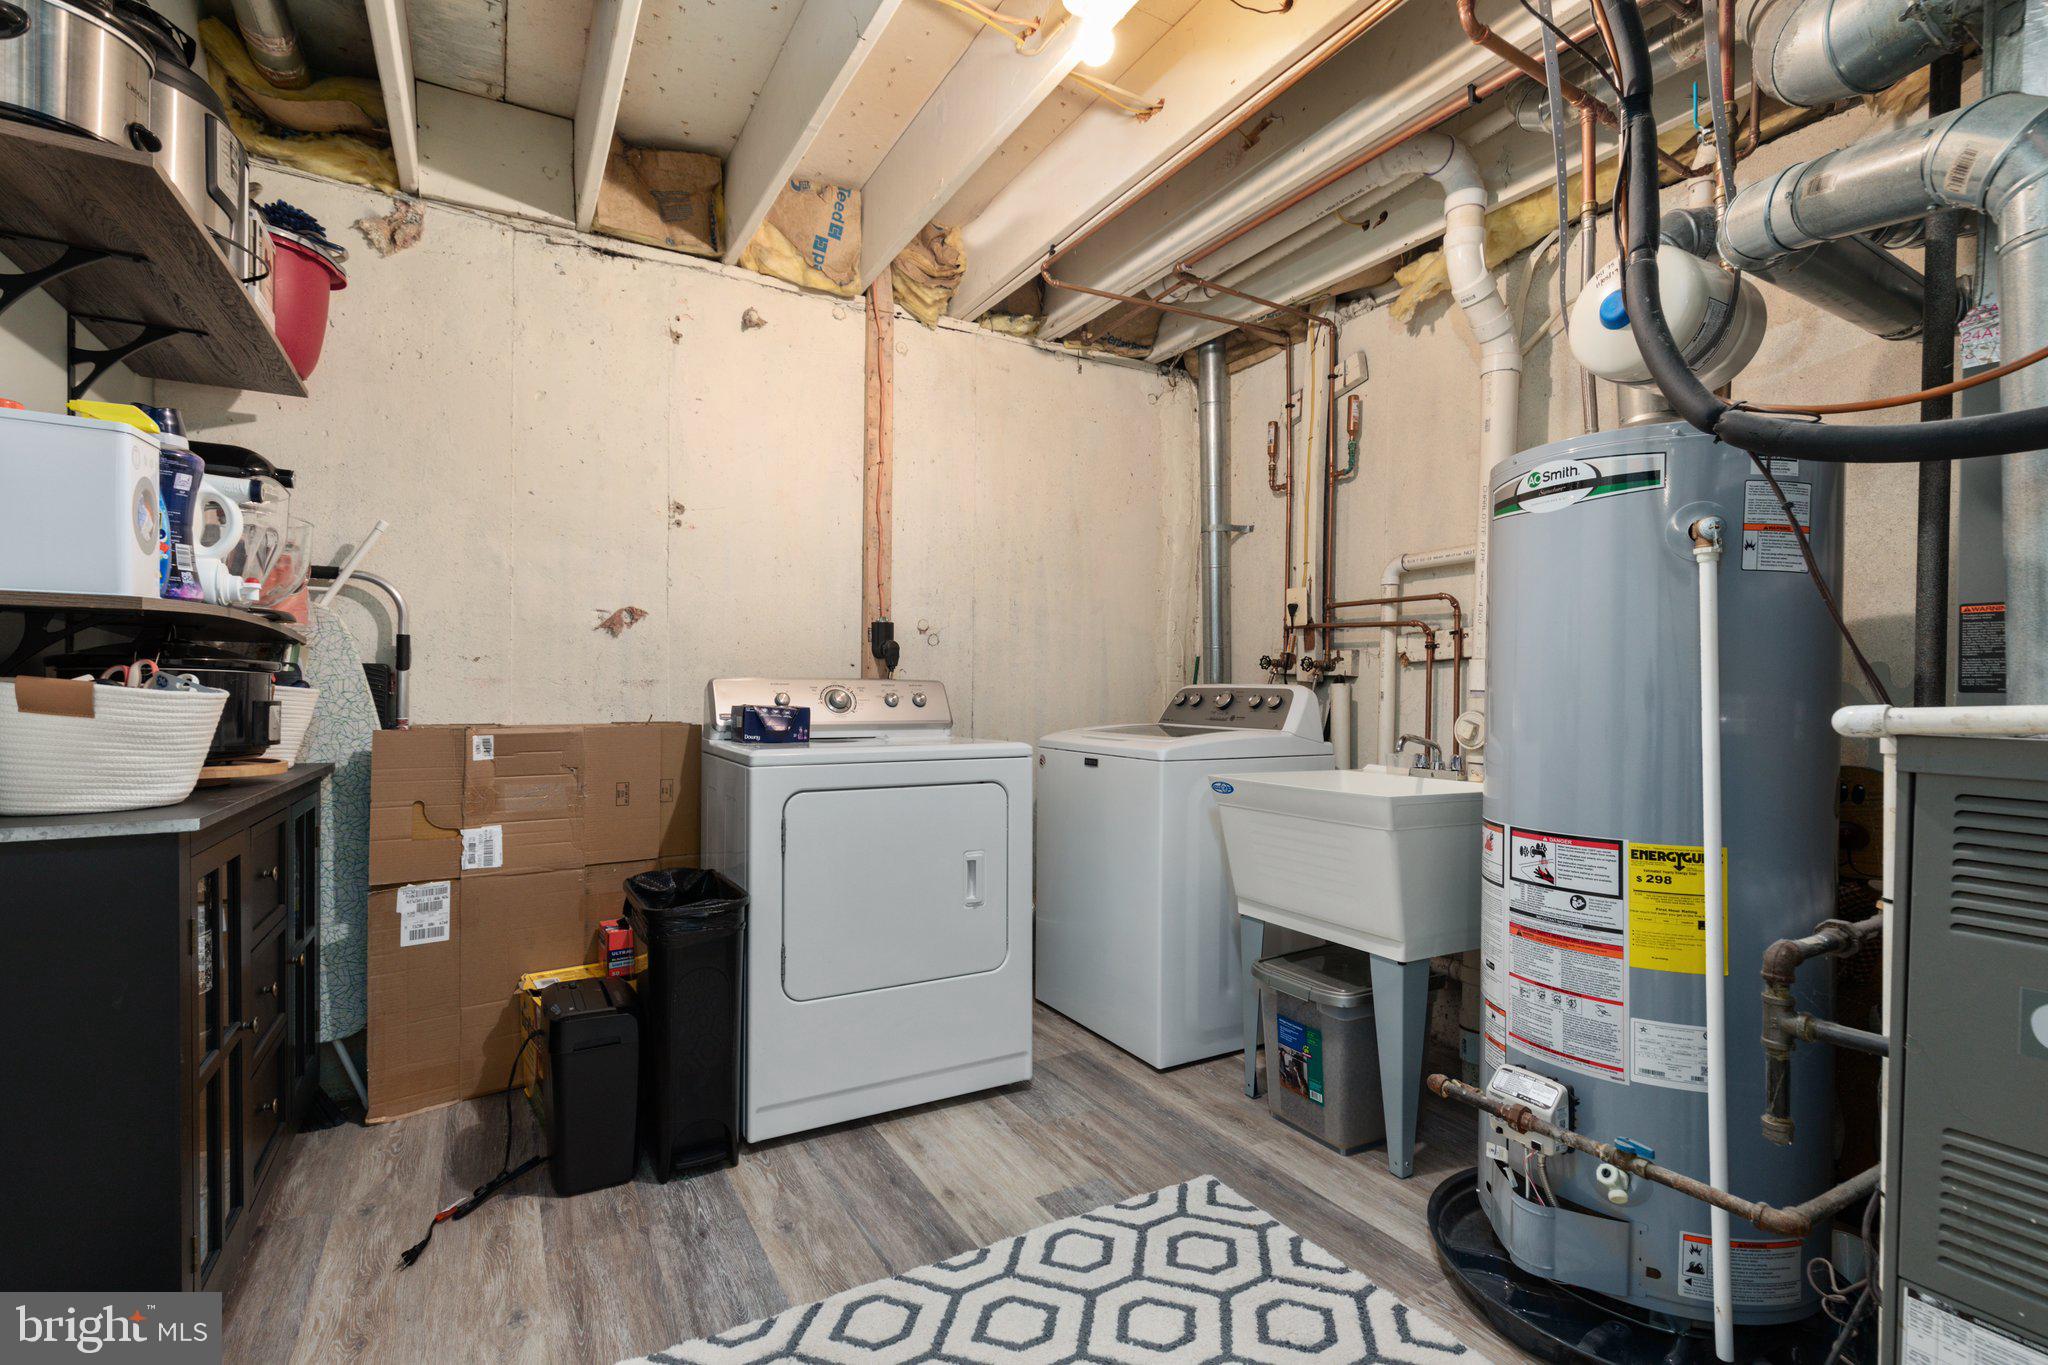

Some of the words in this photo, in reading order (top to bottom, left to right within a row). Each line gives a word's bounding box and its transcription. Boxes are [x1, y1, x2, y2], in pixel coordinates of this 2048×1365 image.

[1542, 466, 1578, 483] Smith
[1971, 604, 2006, 612] WARNIN
[1549, 837, 1573, 845] DANGER
[1630, 849, 1705, 866] ENERGYGUI
[1645, 874, 1672, 885] 298
